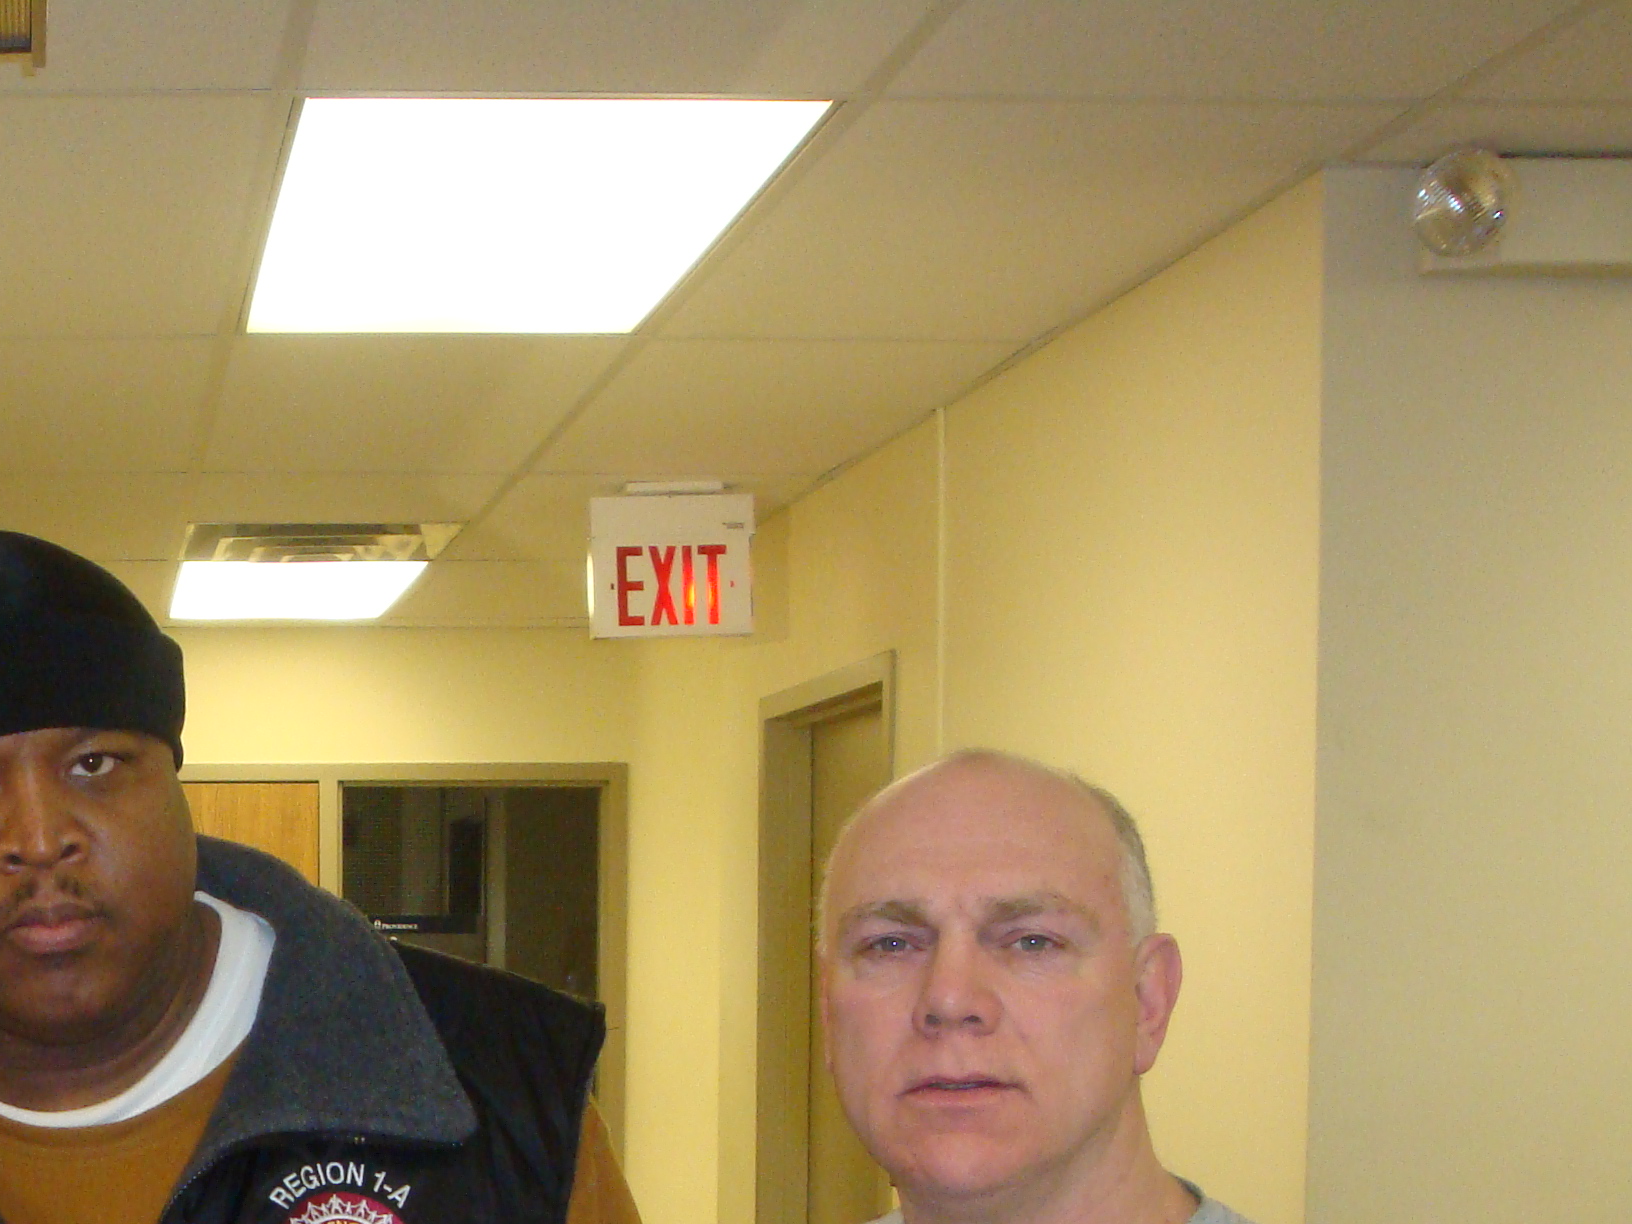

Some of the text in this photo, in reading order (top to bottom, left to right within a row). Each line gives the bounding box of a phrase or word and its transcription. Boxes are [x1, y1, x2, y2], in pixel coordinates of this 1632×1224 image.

[616, 544, 727, 627] EXIT
[269, 1162, 411, 1209] REGION 1-A
